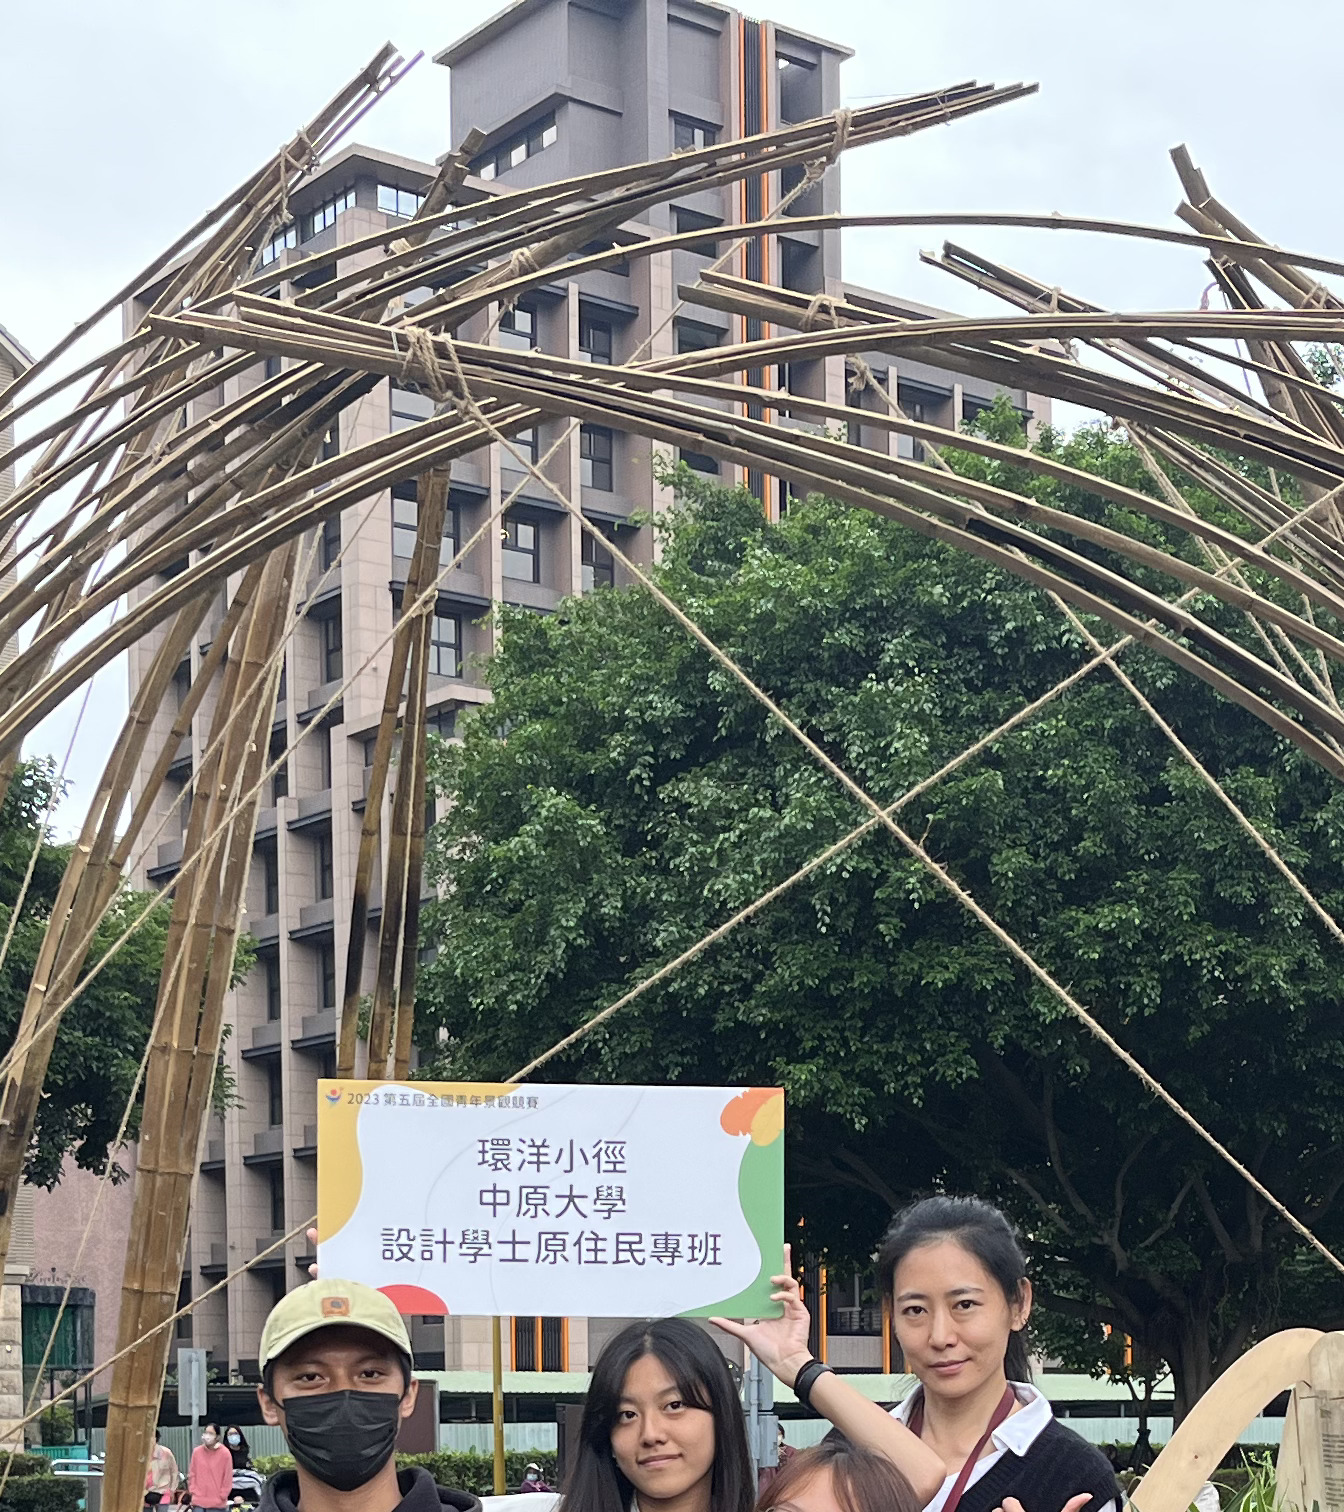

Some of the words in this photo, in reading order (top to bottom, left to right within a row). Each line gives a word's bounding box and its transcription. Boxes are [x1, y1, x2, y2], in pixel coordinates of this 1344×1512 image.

[347, 1093, 380, 1105] 2023
[477, 1138, 628, 1174] 環洋小徑
[478, 1184, 627, 1220] 中原大學
[381, 1227, 723, 1267] 設計學士原住民專班
